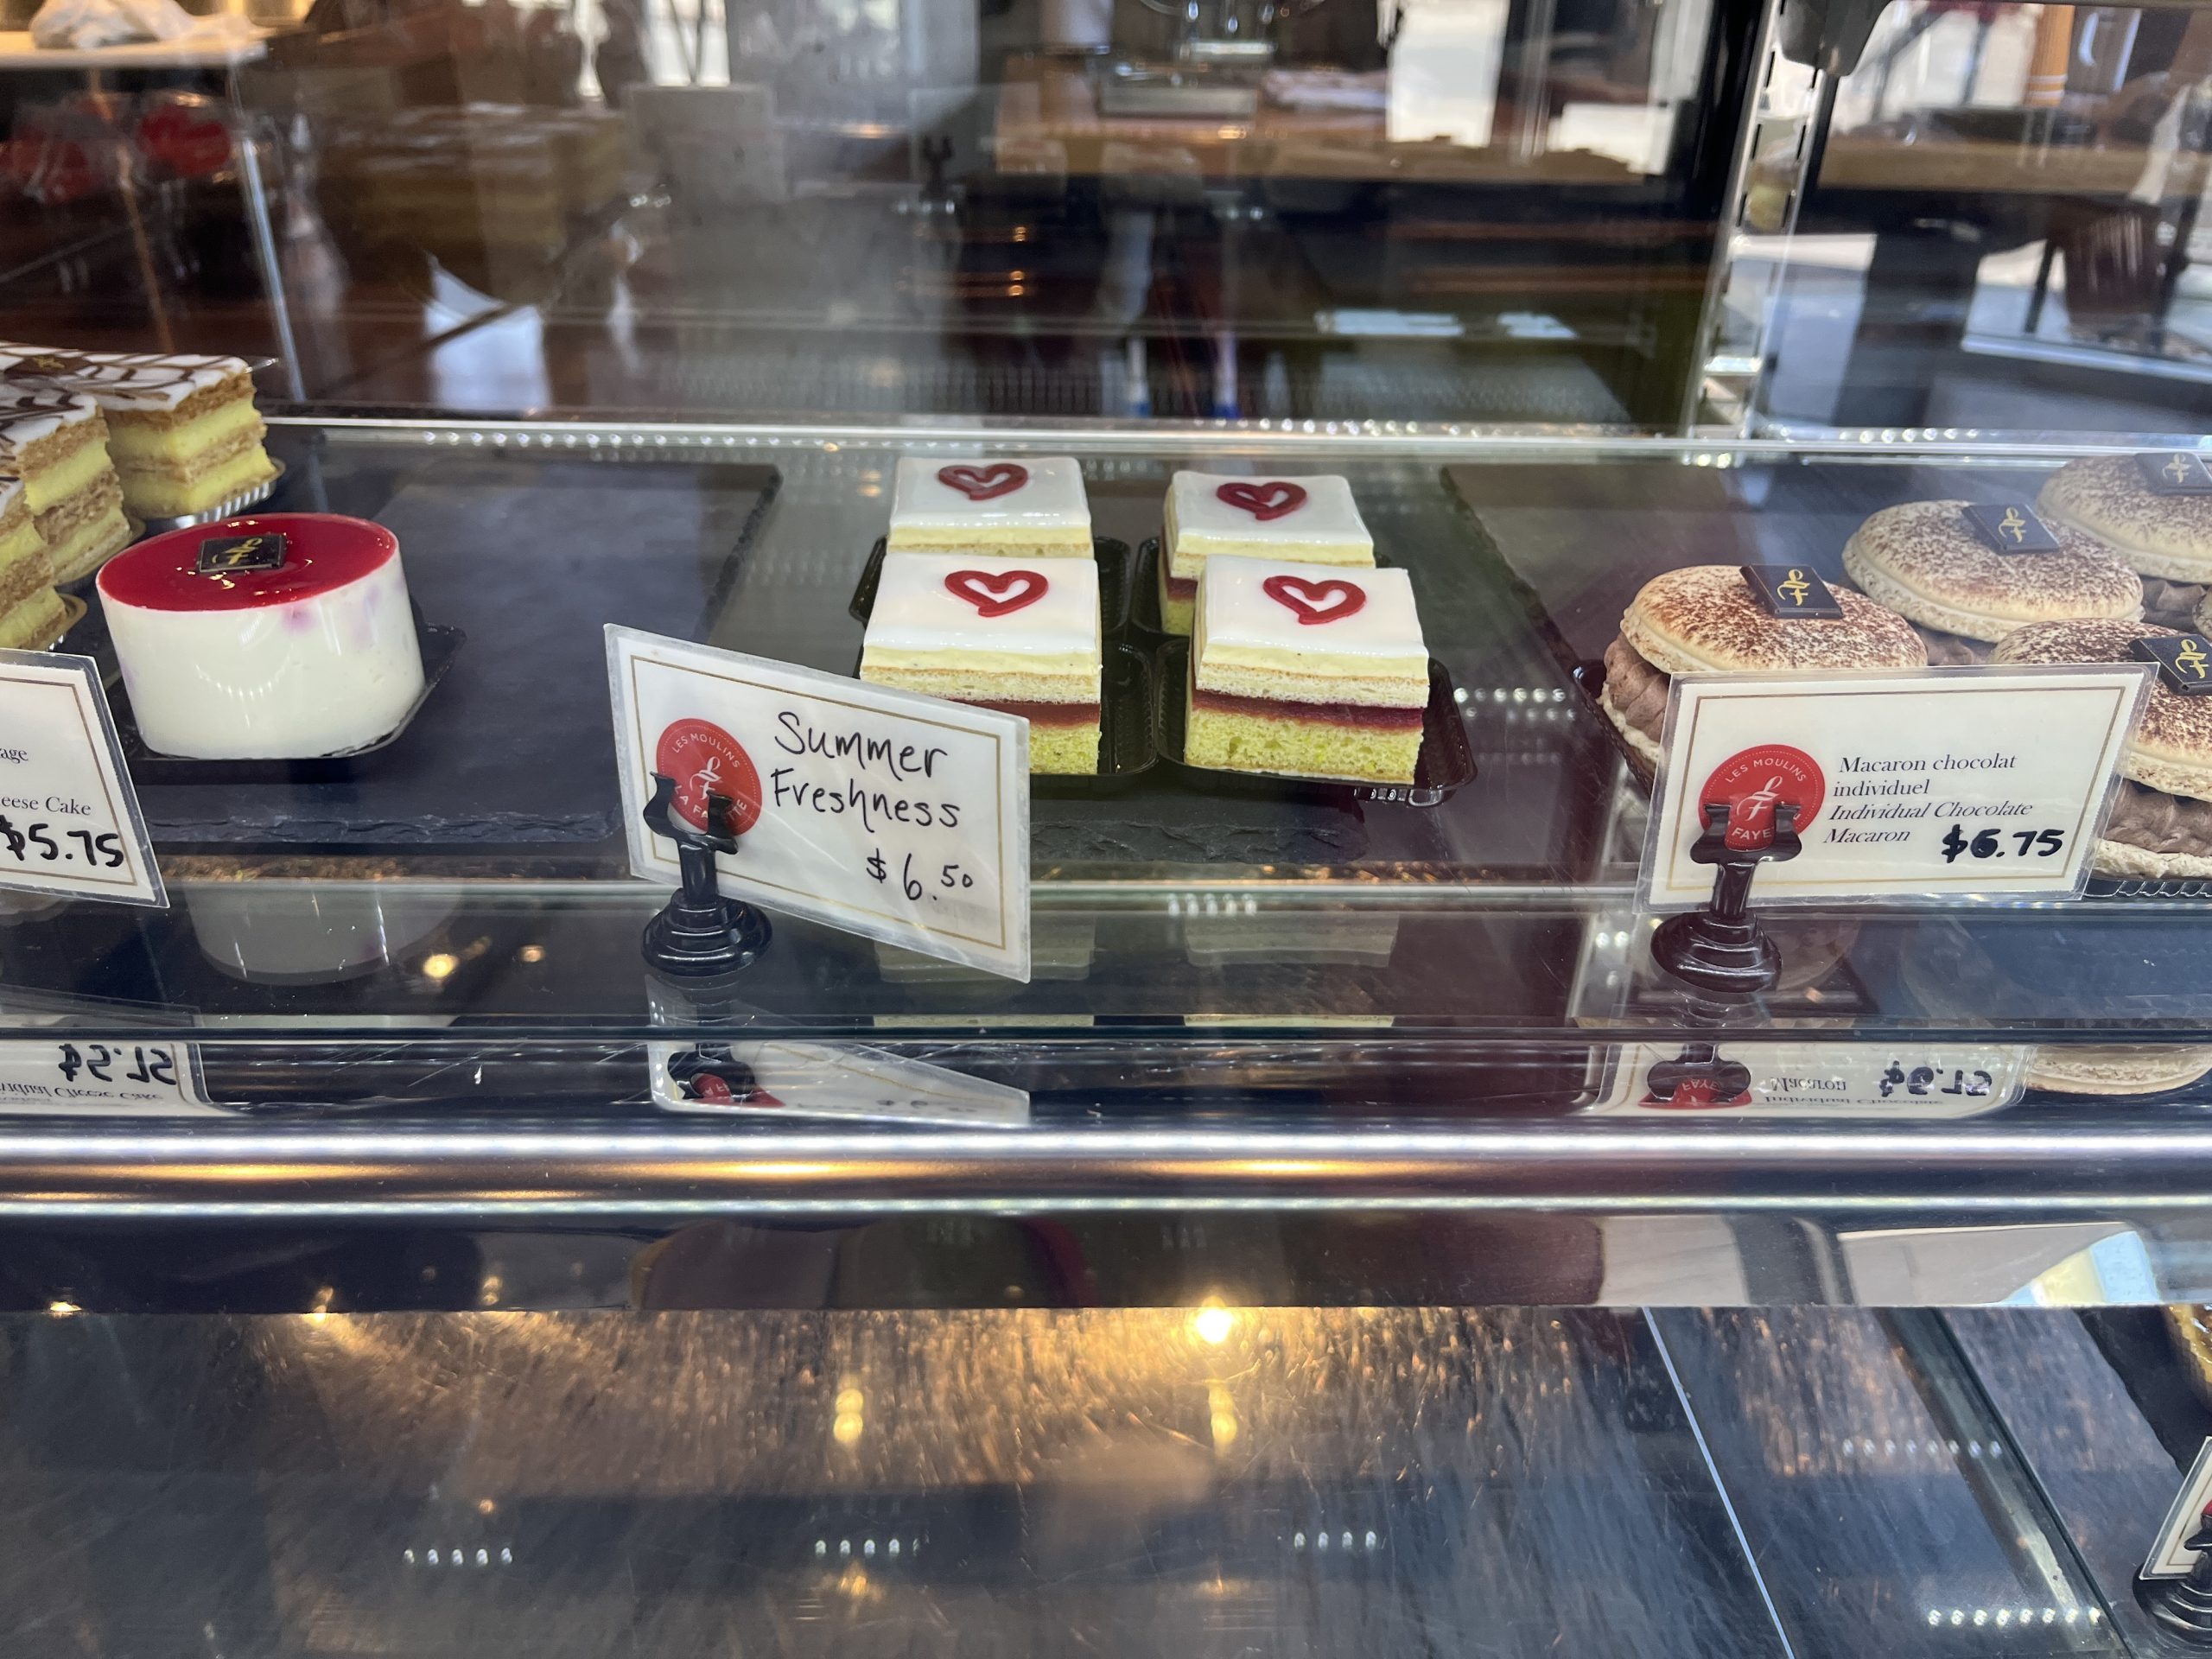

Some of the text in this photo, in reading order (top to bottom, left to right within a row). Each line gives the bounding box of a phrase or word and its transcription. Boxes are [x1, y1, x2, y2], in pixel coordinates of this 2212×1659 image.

[671, 733, 741, 768] LES MOULINS
[774, 711, 948, 782] Summer
[1725, 758, 1807, 784] LES MOULINS
[1838, 753, 2018, 773] Macaron chocolat
[771, 768, 961, 834] Freshness
[1833, 779, 1930, 797] individuel
[1, 797, 92, 816] eese Cake
[692, 798, 747, 822] FATTE
[1829, 800, 2033, 821] Individual Chocolate
[0, 815, 124, 868] $5.75
[1823, 823, 2065, 864] Macaron $6.75
